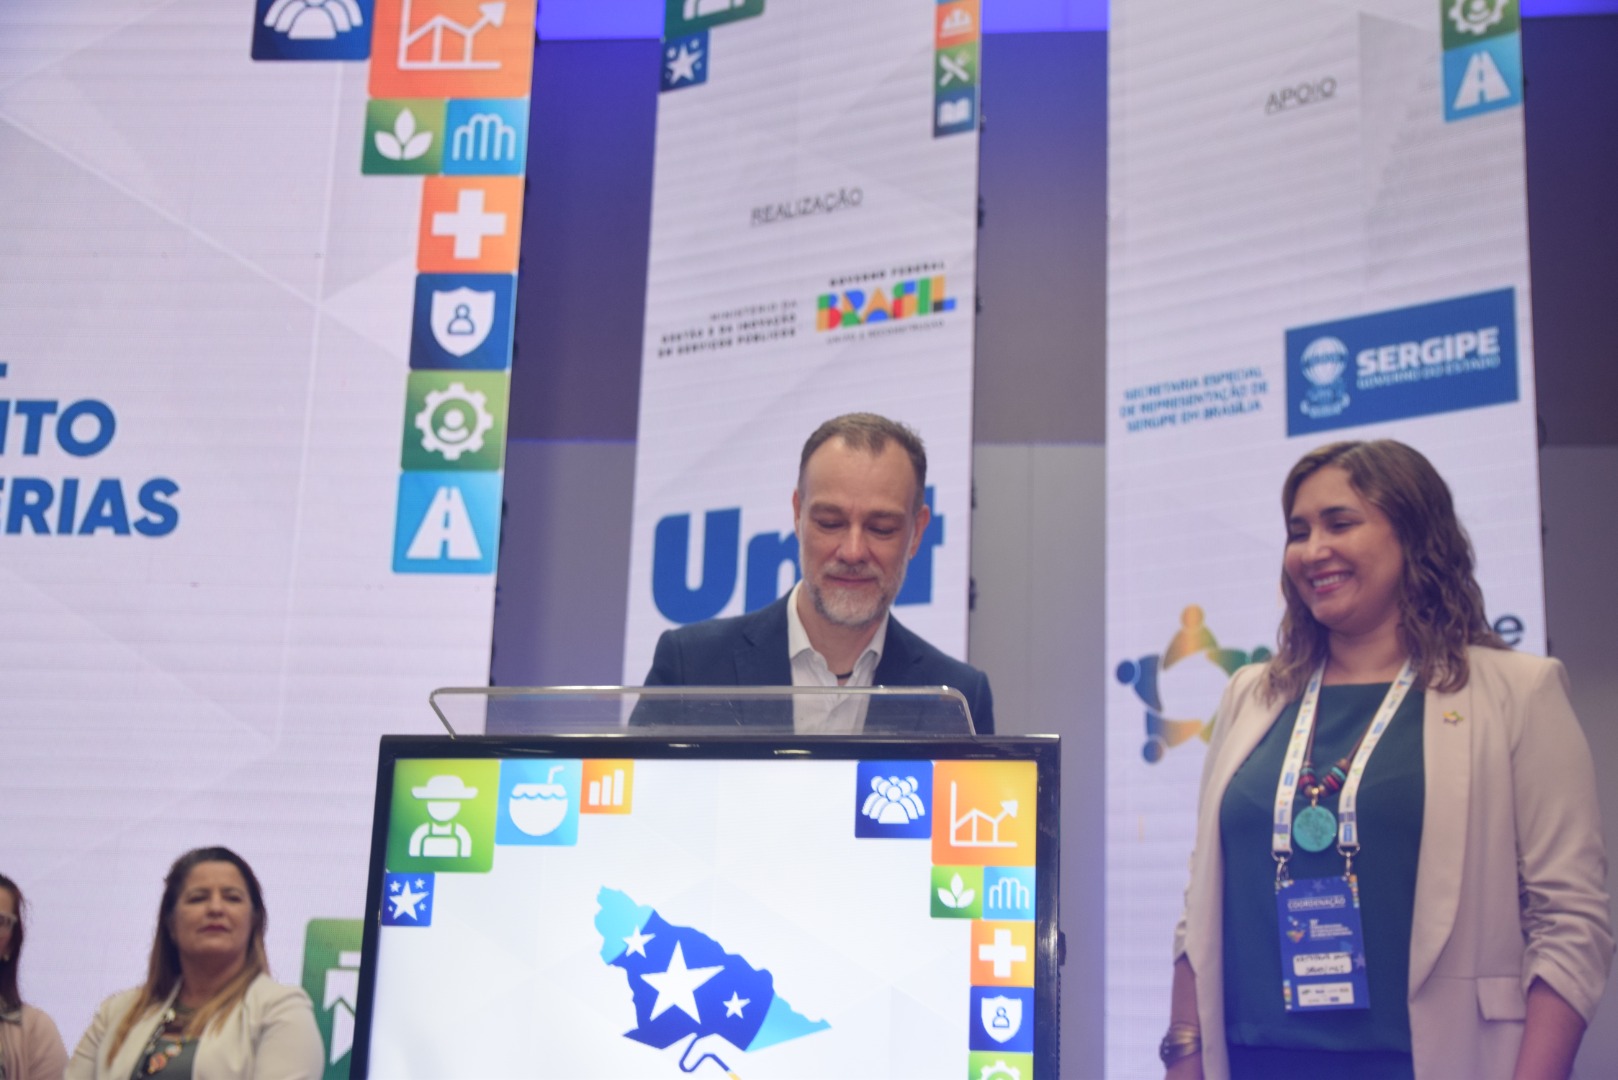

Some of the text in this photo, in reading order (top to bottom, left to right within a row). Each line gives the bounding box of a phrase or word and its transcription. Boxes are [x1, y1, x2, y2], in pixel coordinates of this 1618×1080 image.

[1264, 75, 1337, 115] APOIO
[751, 187, 863, 226] REALIZAÇÃO
[816, 273, 957, 332] BRASIL
[1356, 326, 1500, 376] SERGIPE
[1203, 366, 1262, 386] ESPECIAL
[1356, 367, 1418, 390] GOVERNO
[1420, 364, 1443, 380] DO
[0, 399, 116, 457] TO
[0, 477, 180, 537] RIAS
